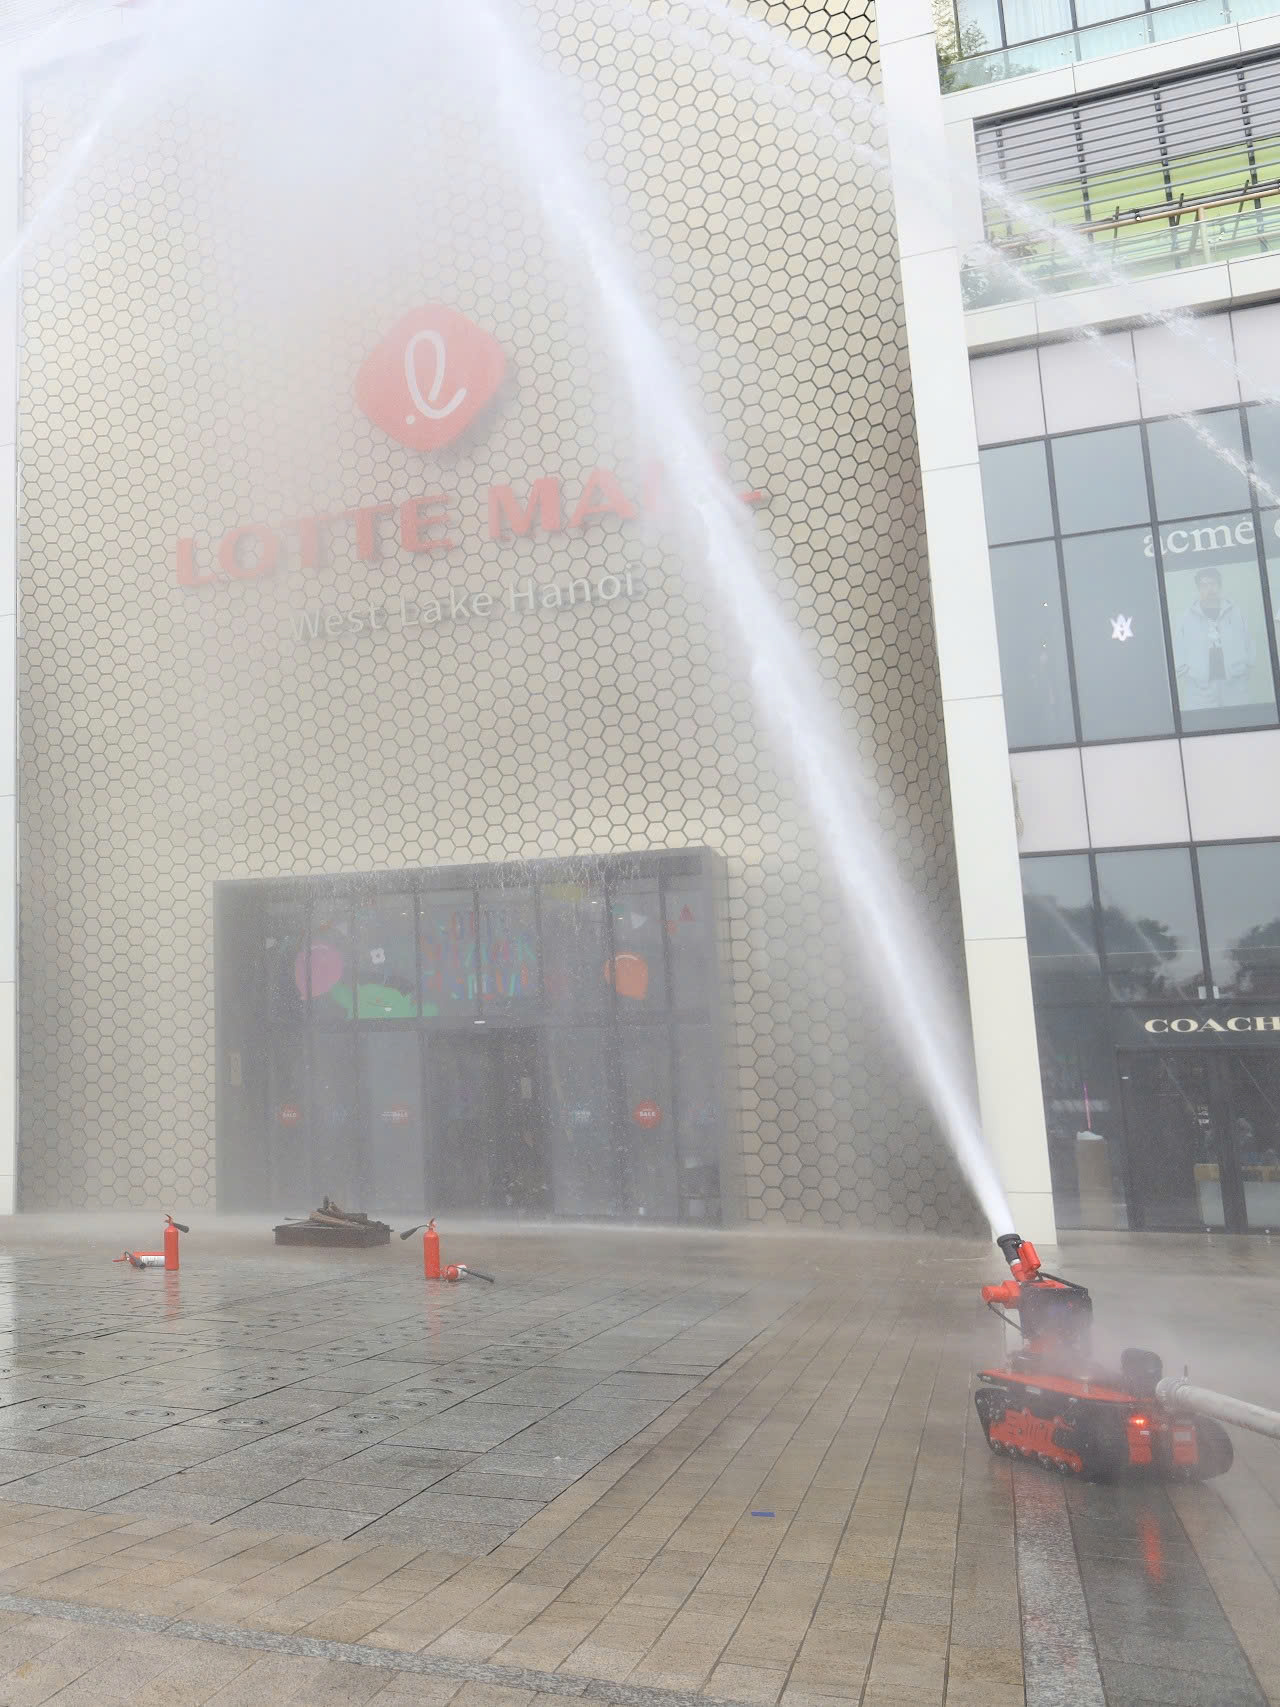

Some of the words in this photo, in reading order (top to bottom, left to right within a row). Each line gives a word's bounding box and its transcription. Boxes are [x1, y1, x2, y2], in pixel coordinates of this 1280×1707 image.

[176, 493, 456, 588] LOTTE
[288, 604, 383, 643] West
[400, 585, 493, 630] Lake
[507, 563, 637, 615] Hanoi
[1144, 1016, 1280, 1033] COACH
